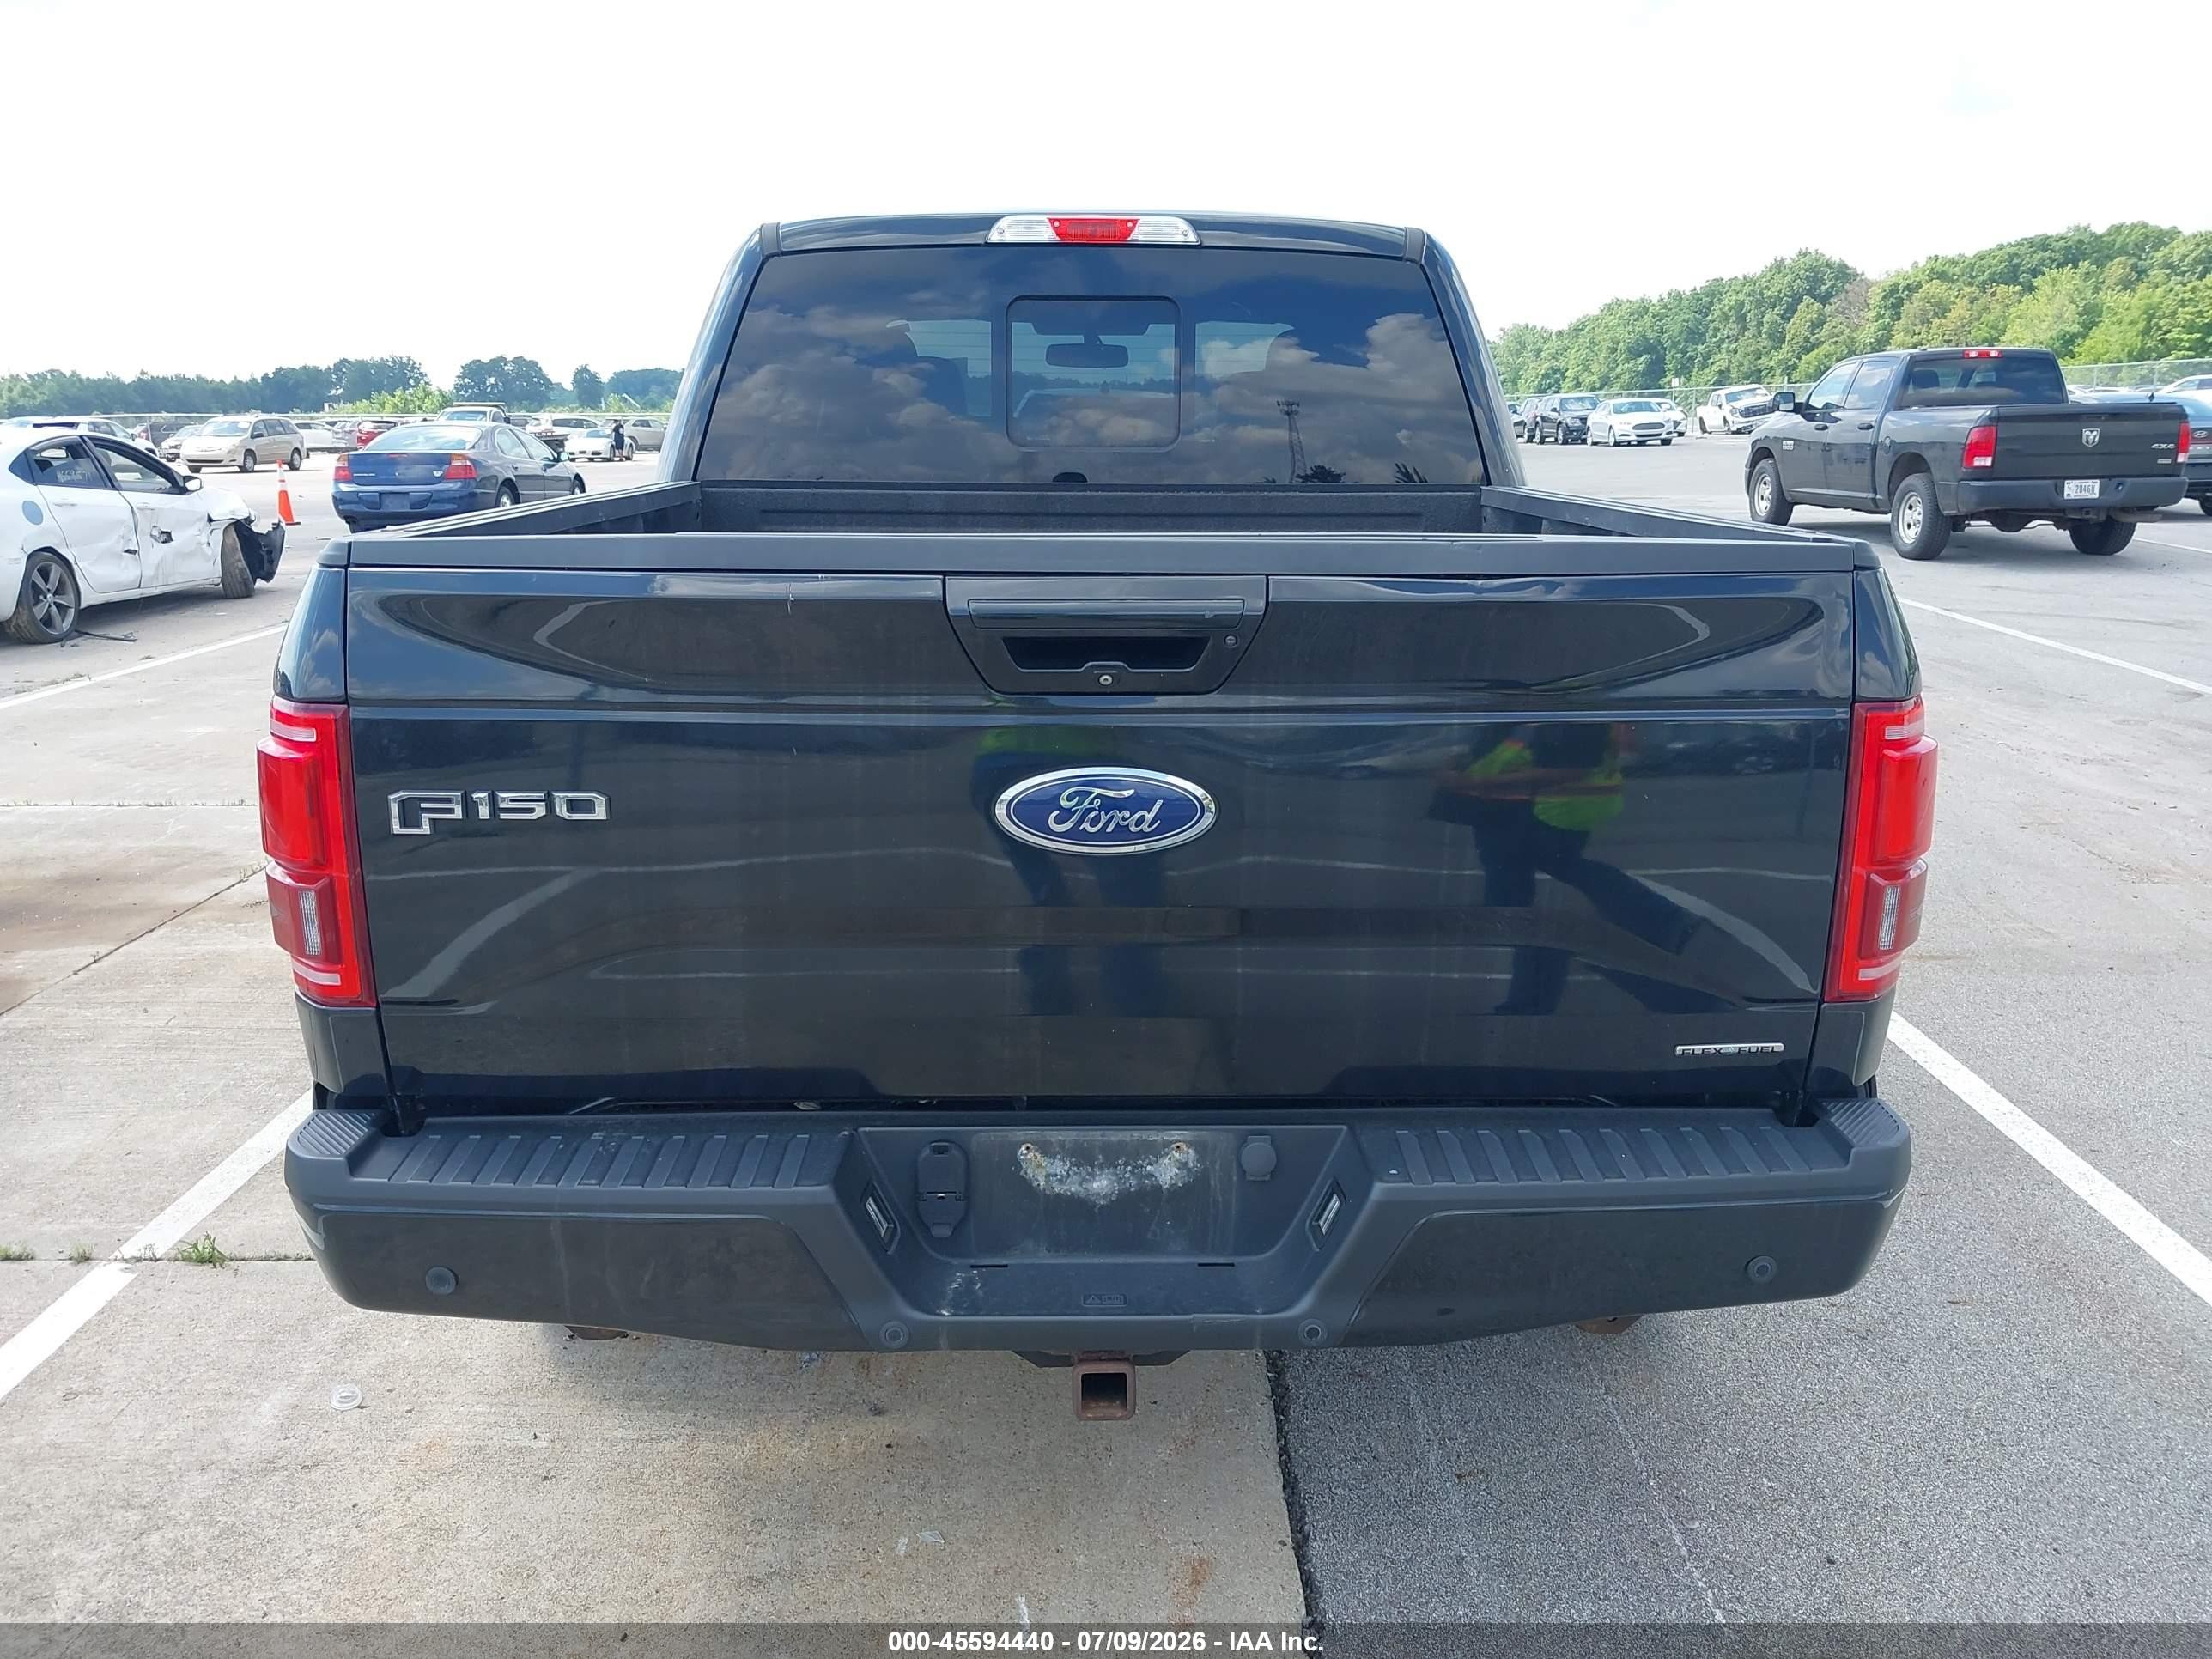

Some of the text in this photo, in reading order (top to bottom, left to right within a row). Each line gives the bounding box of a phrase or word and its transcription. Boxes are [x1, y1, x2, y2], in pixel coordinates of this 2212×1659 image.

[1048, 787, 1164, 833] Ford
[1681, 1045, 1781, 1056] FLEX FUEL
